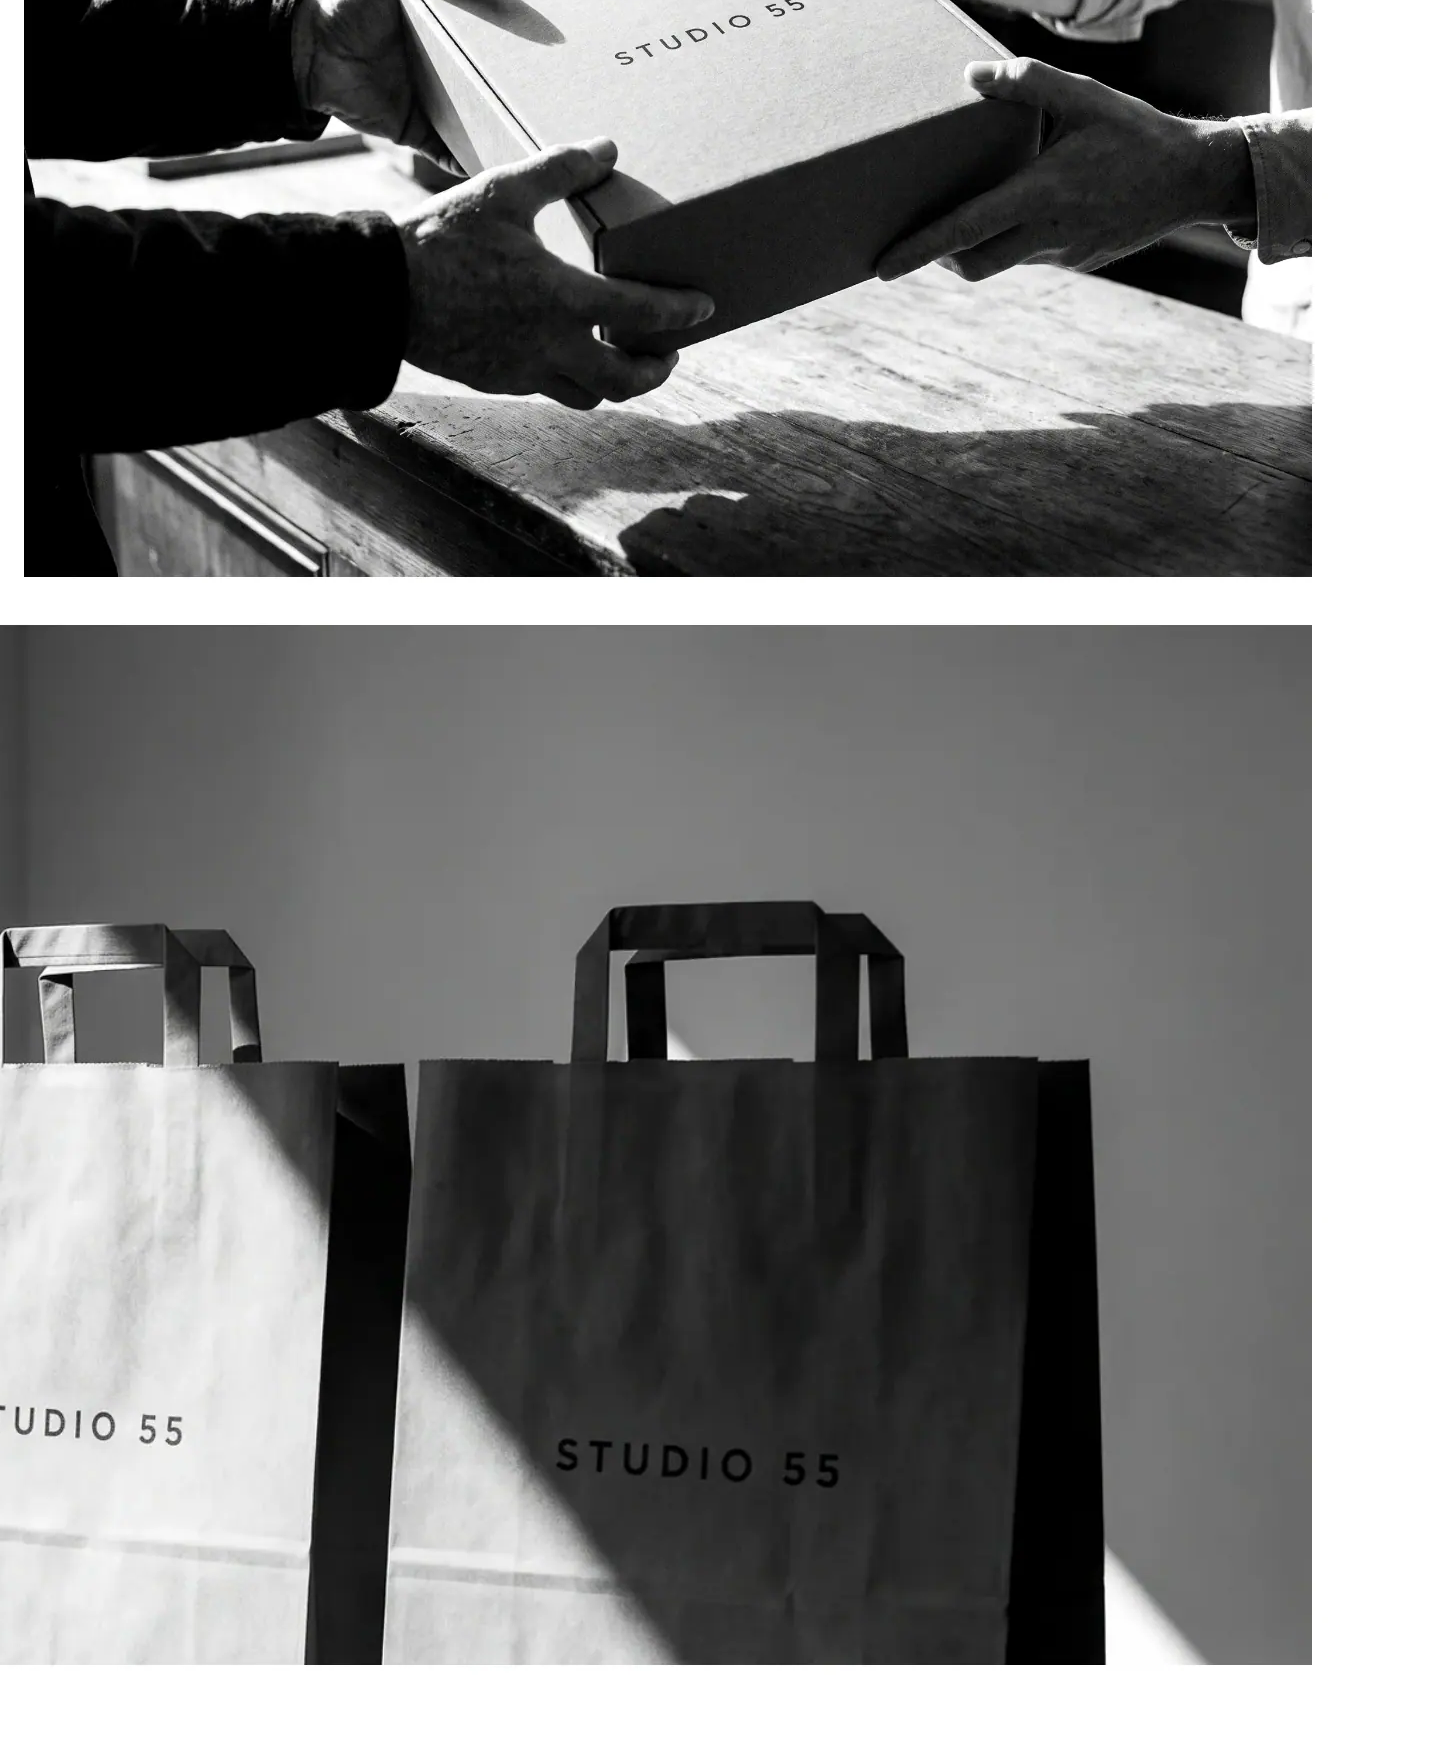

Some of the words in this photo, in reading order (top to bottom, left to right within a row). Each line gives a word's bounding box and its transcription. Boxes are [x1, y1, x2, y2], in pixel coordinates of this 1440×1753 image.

[614, 14, 752, 66] STUDIO
[139, 1413, 184, 1447] 55
[555, 1437, 753, 1483] STUDIO
[781, 1451, 841, 1489] 55
